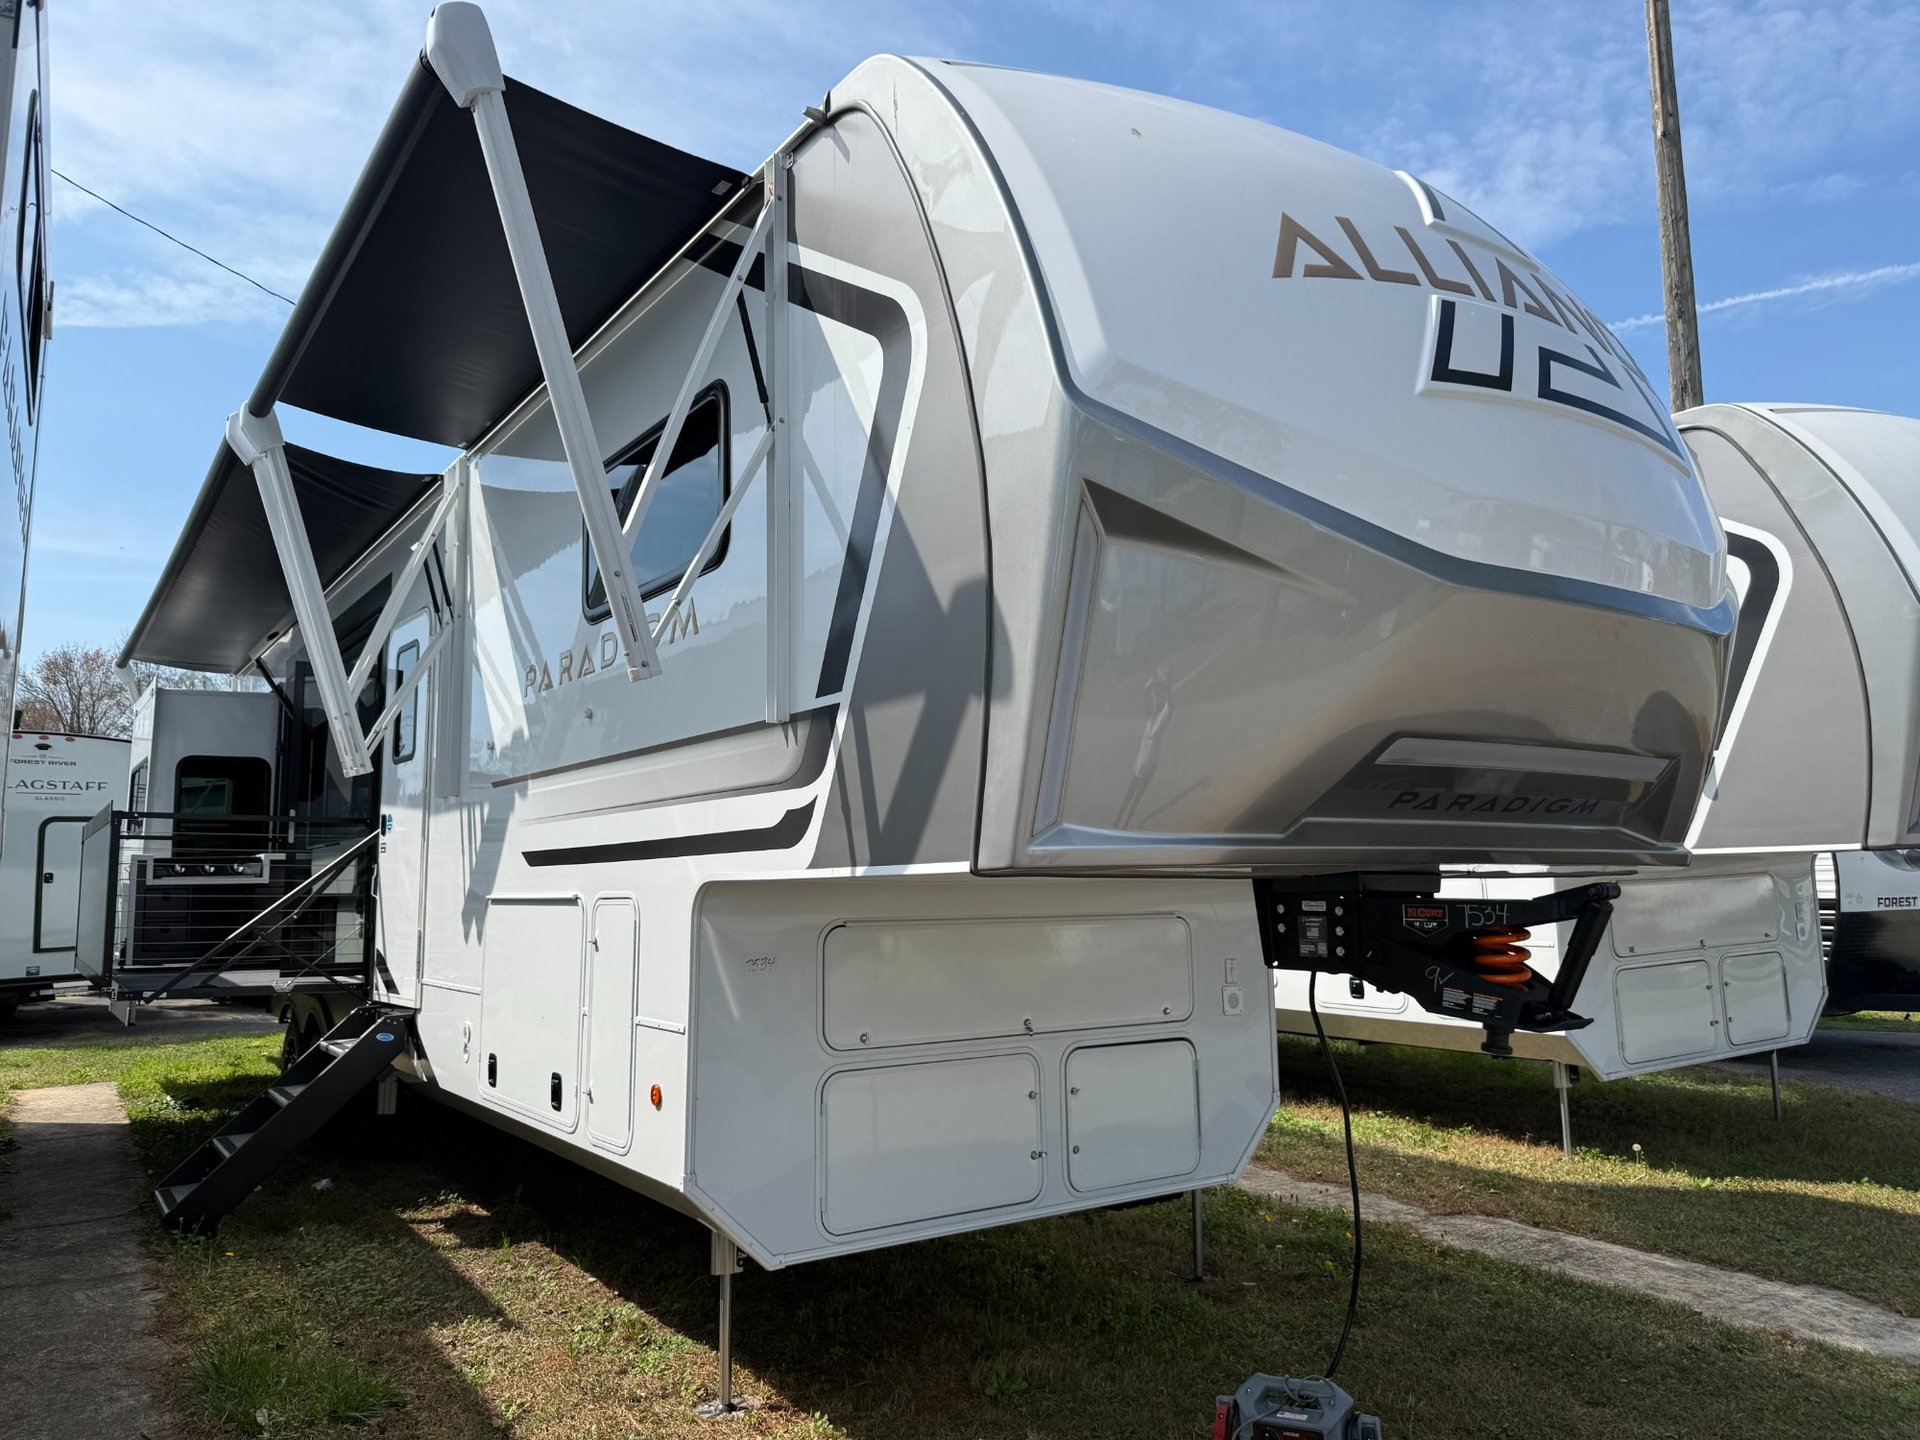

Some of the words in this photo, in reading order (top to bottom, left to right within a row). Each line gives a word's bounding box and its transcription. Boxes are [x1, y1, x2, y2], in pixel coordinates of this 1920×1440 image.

[1387, 790, 1601, 815] PARADIGM
[1877, 896, 1918, 908] FOREST
[1455, 903, 1511, 929] 7534
